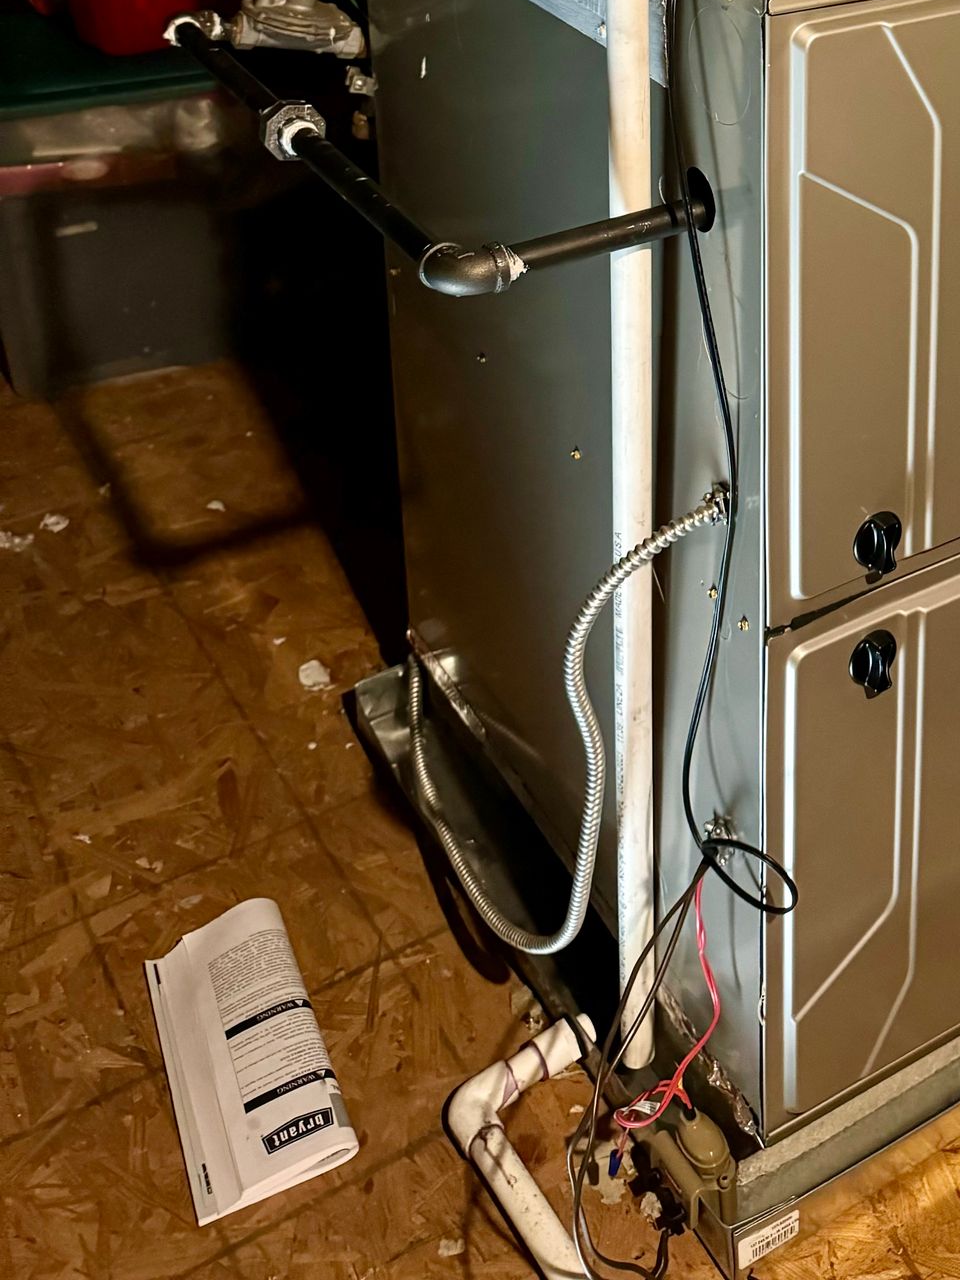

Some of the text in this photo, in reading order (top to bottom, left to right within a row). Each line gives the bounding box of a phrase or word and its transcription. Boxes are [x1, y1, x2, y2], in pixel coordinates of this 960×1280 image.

[256, 1002, 294, 1021] WARNING
[277, 1074, 316, 1095] WARNING
[272, 1113, 325, 1147] bryant
